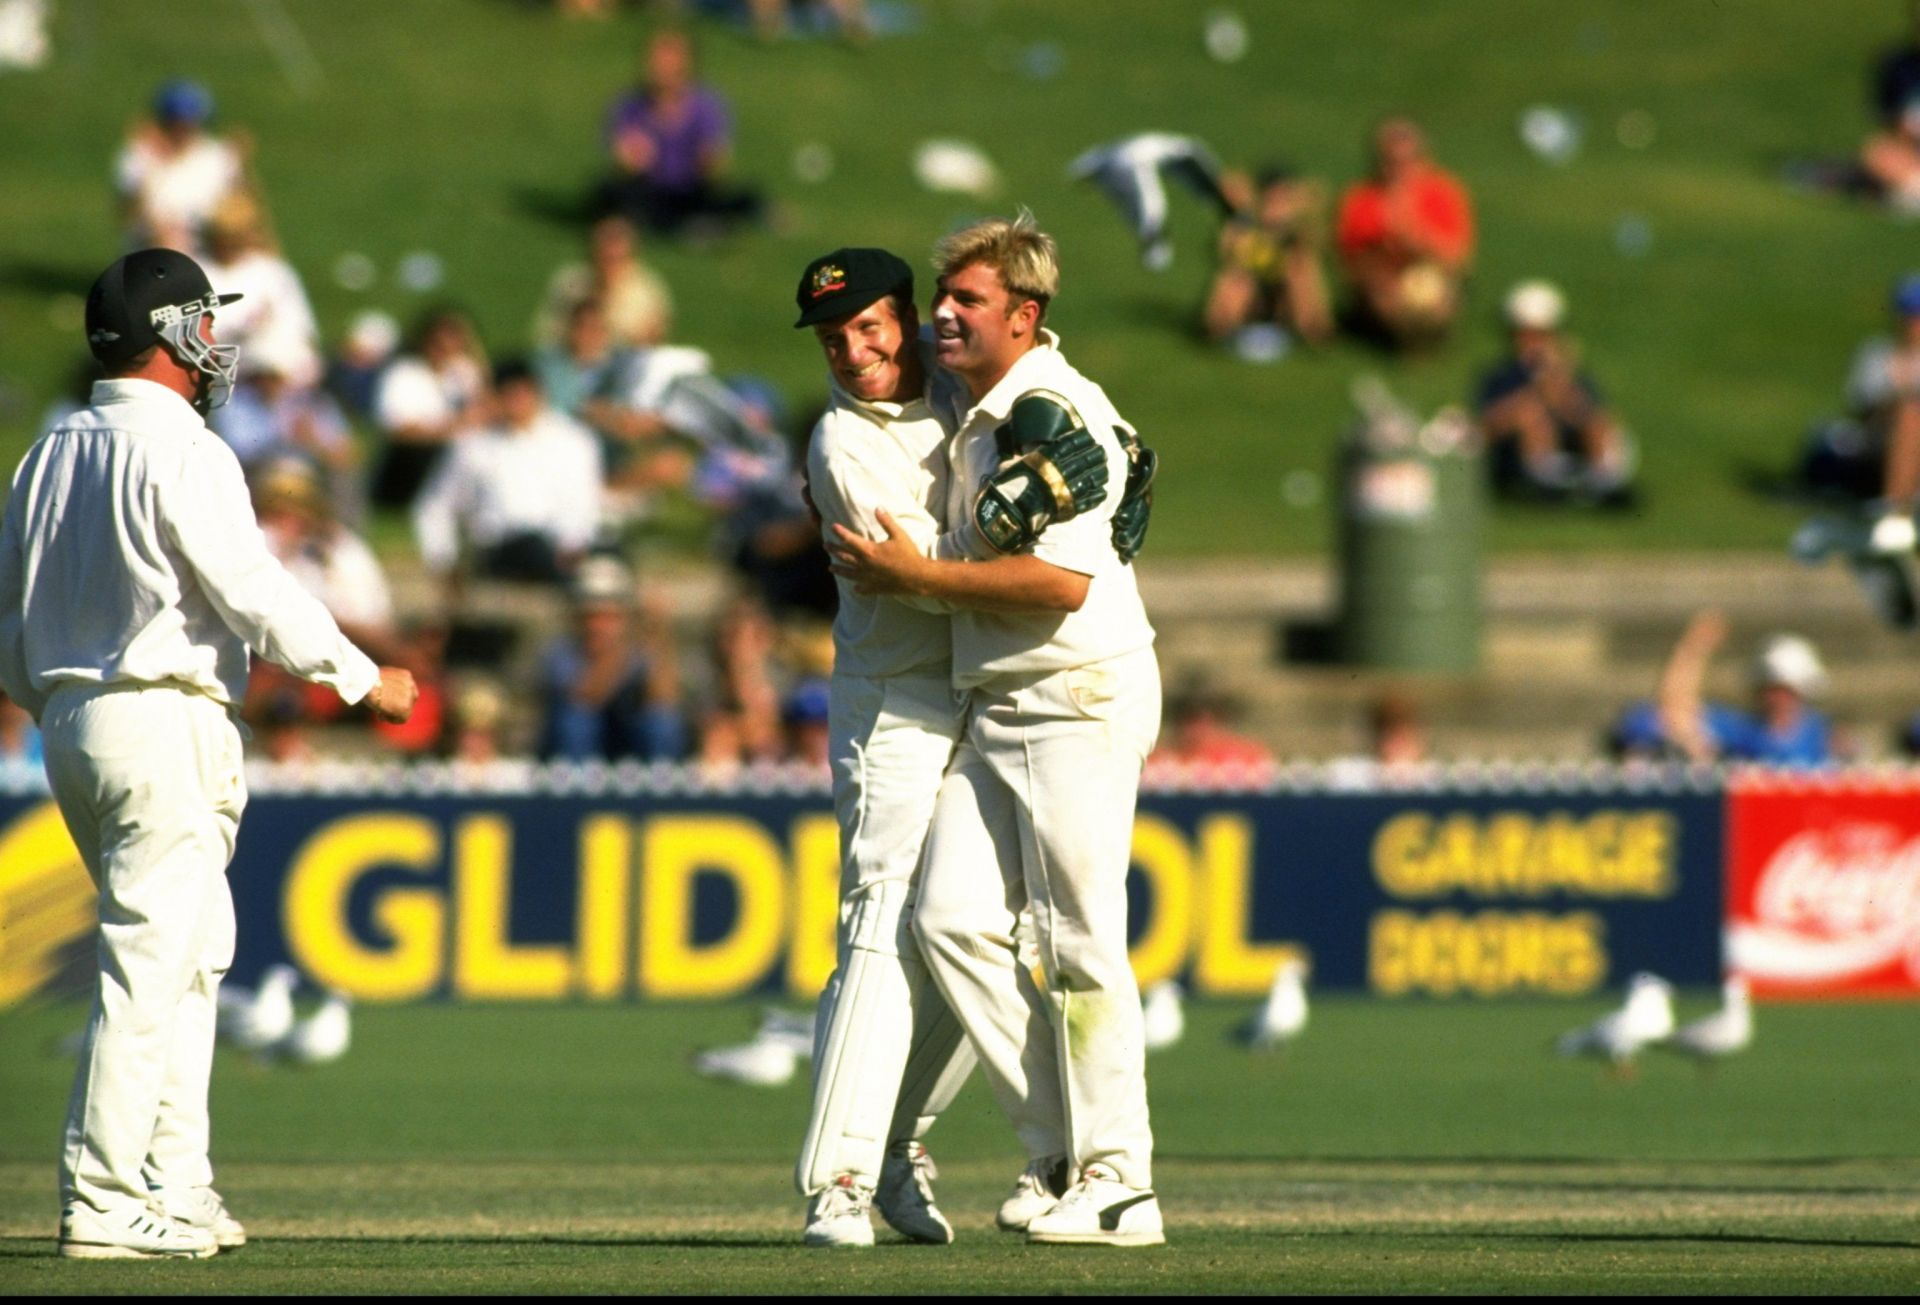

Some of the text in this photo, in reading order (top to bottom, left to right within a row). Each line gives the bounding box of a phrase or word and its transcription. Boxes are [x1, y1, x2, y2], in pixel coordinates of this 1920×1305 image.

[1370, 811, 1676, 895] GARAGE
[283, 814, 1310, 1000] GLIDEL
[1369, 908, 1606, 995] DOORS
